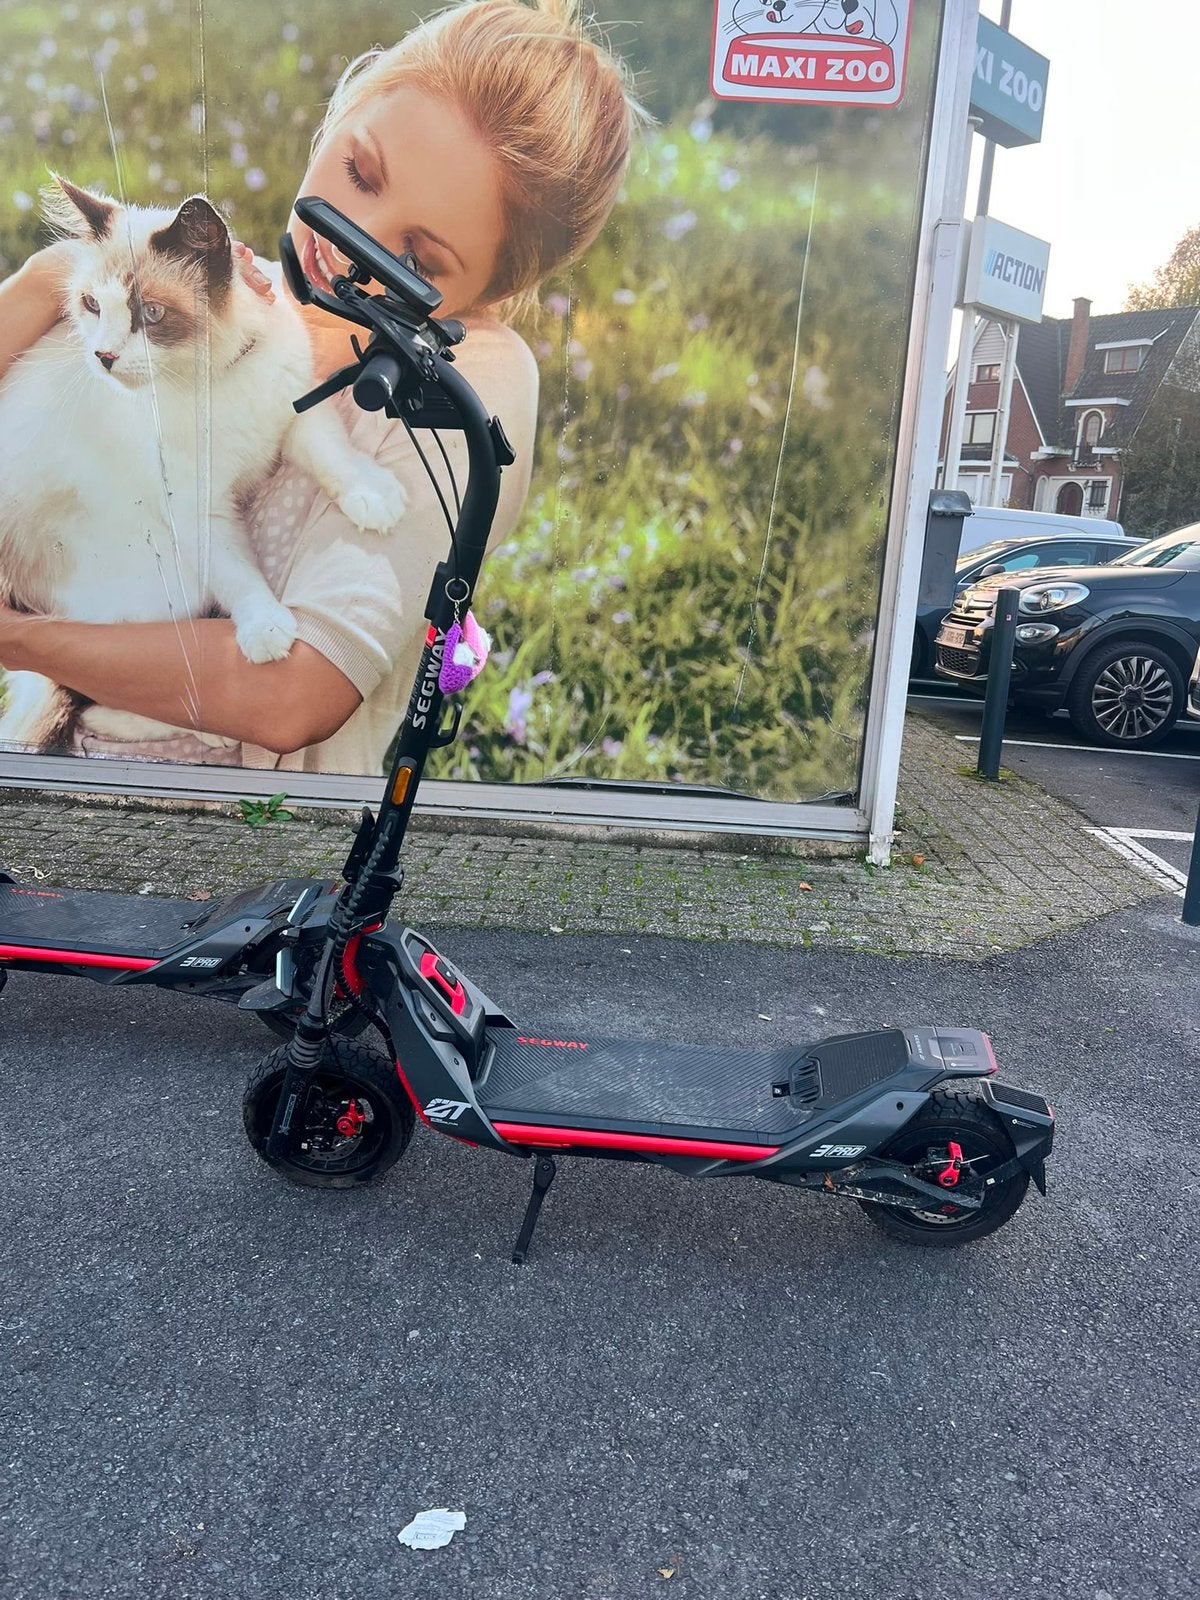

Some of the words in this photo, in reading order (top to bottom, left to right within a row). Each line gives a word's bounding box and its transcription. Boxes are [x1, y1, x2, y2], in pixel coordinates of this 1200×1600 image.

[731, 54, 817, 80] MAXI
[825, 58, 890, 83] ZOO
[998, 59, 1043, 112] ZOO
[991, 252, 1045, 294] ACTION
[412, 626, 447, 730] SEGWAY
[193, 957, 219, 967] PRO
[517, 1036, 589, 1049] SEGWAY
[809, 1144, 834, 1157] 3
[828, 1146, 864, 1156] PRO
